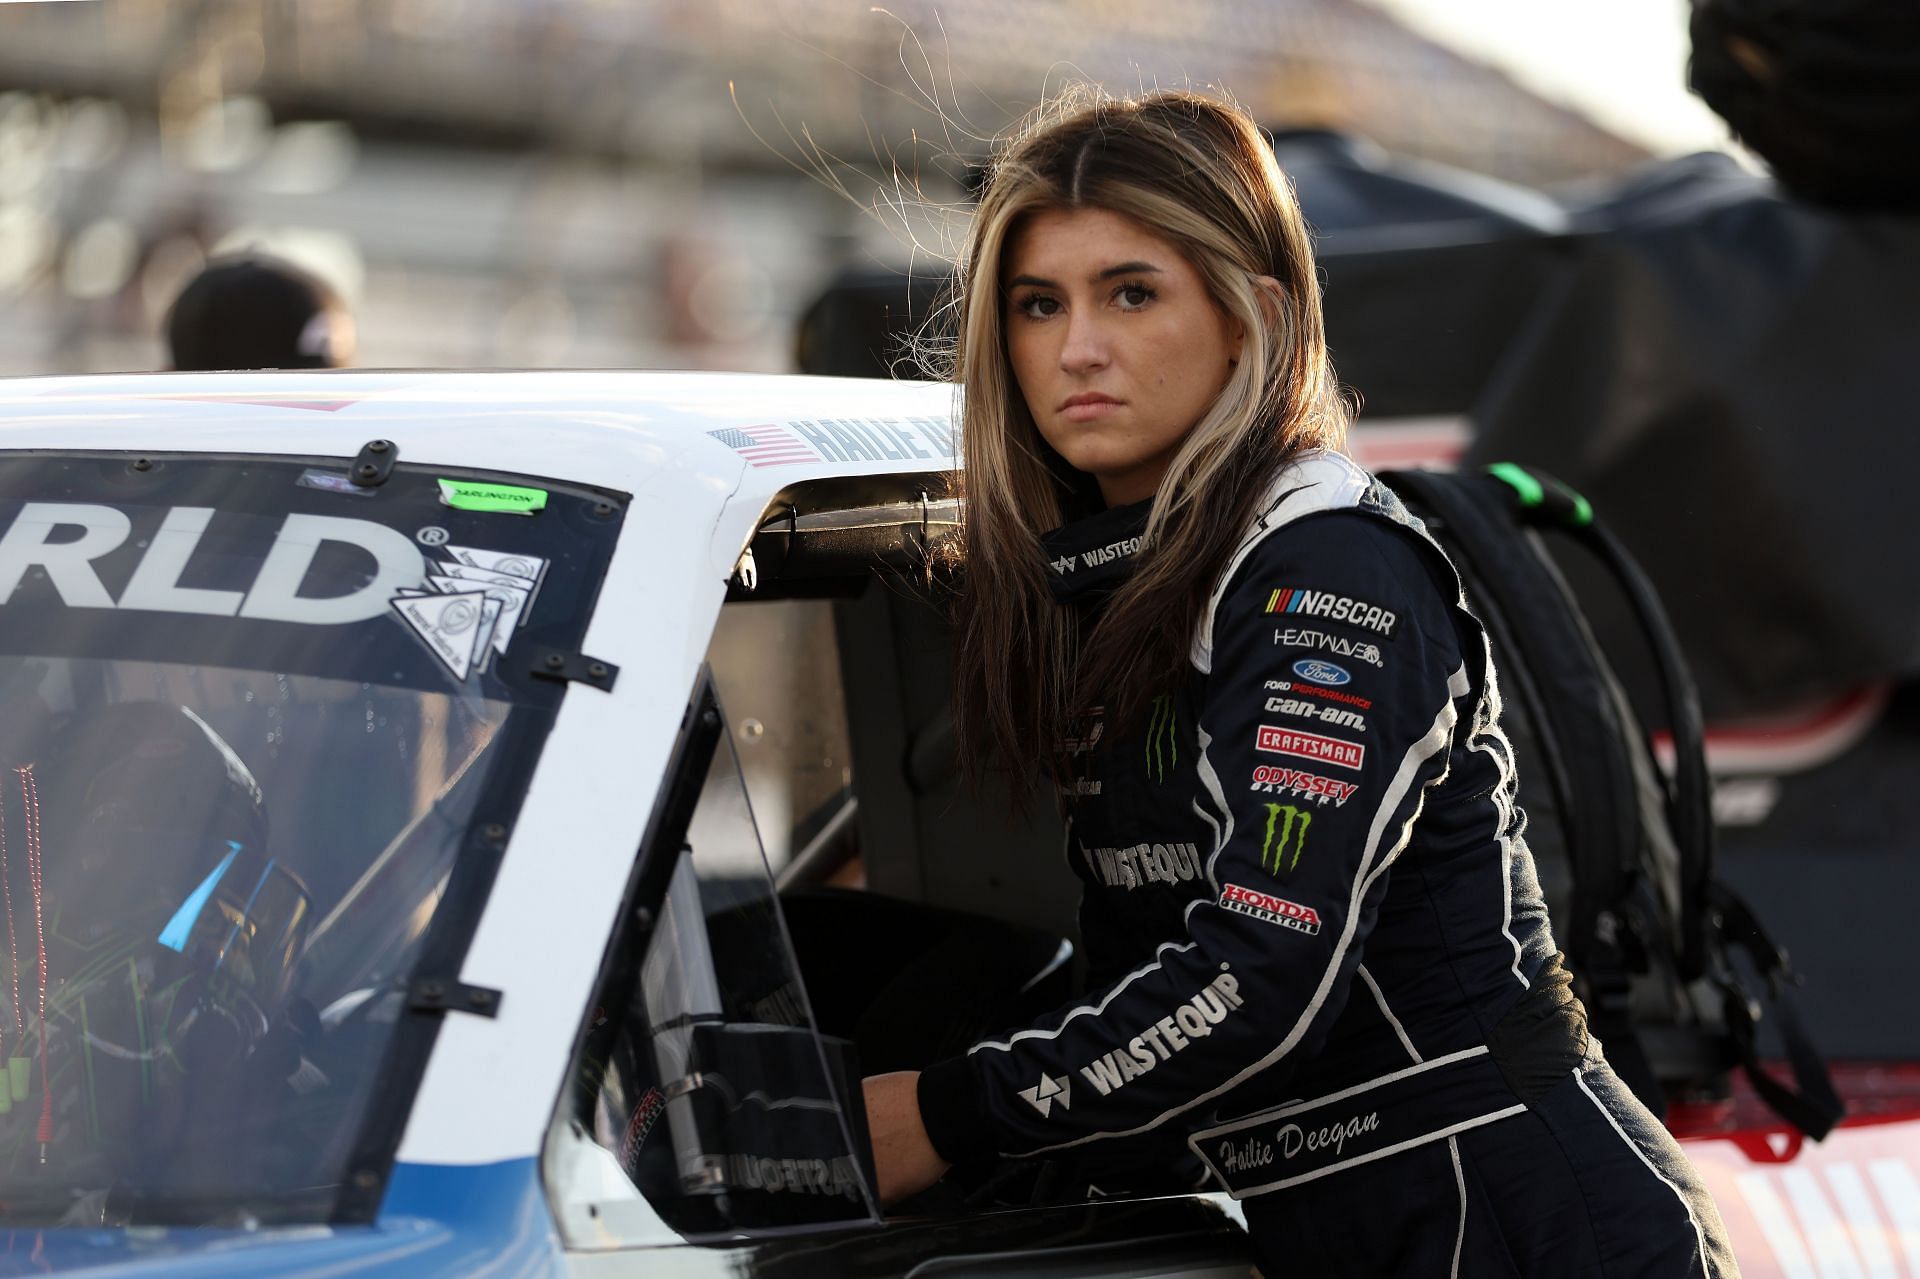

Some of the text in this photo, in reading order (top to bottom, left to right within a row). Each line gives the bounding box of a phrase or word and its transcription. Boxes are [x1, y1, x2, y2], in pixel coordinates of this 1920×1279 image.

[788, 416, 933, 463] HAILIE
[0, 503, 425, 625] RLD
[1297, 590, 1396, 635] NASCAR
[1274, 629, 1367, 658] HEATWAVE
[1302, 662, 1340, 683] Ford
[1264, 680, 1373, 710] FORD PERFORMANCE
[1262, 732, 1358, 763] CRAFTSMAN
[1250, 782, 1347, 808] BATTERY
[1252, 765, 1359, 801] ODYSSEY
[1220, 899, 1321, 934] GENERATORS
[1222, 885, 1320, 925] HONDA
[1080, 972, 1245, 1096] WASTEQUIP
[1218, 1111, 1381, 1175] Hailie Deegan
